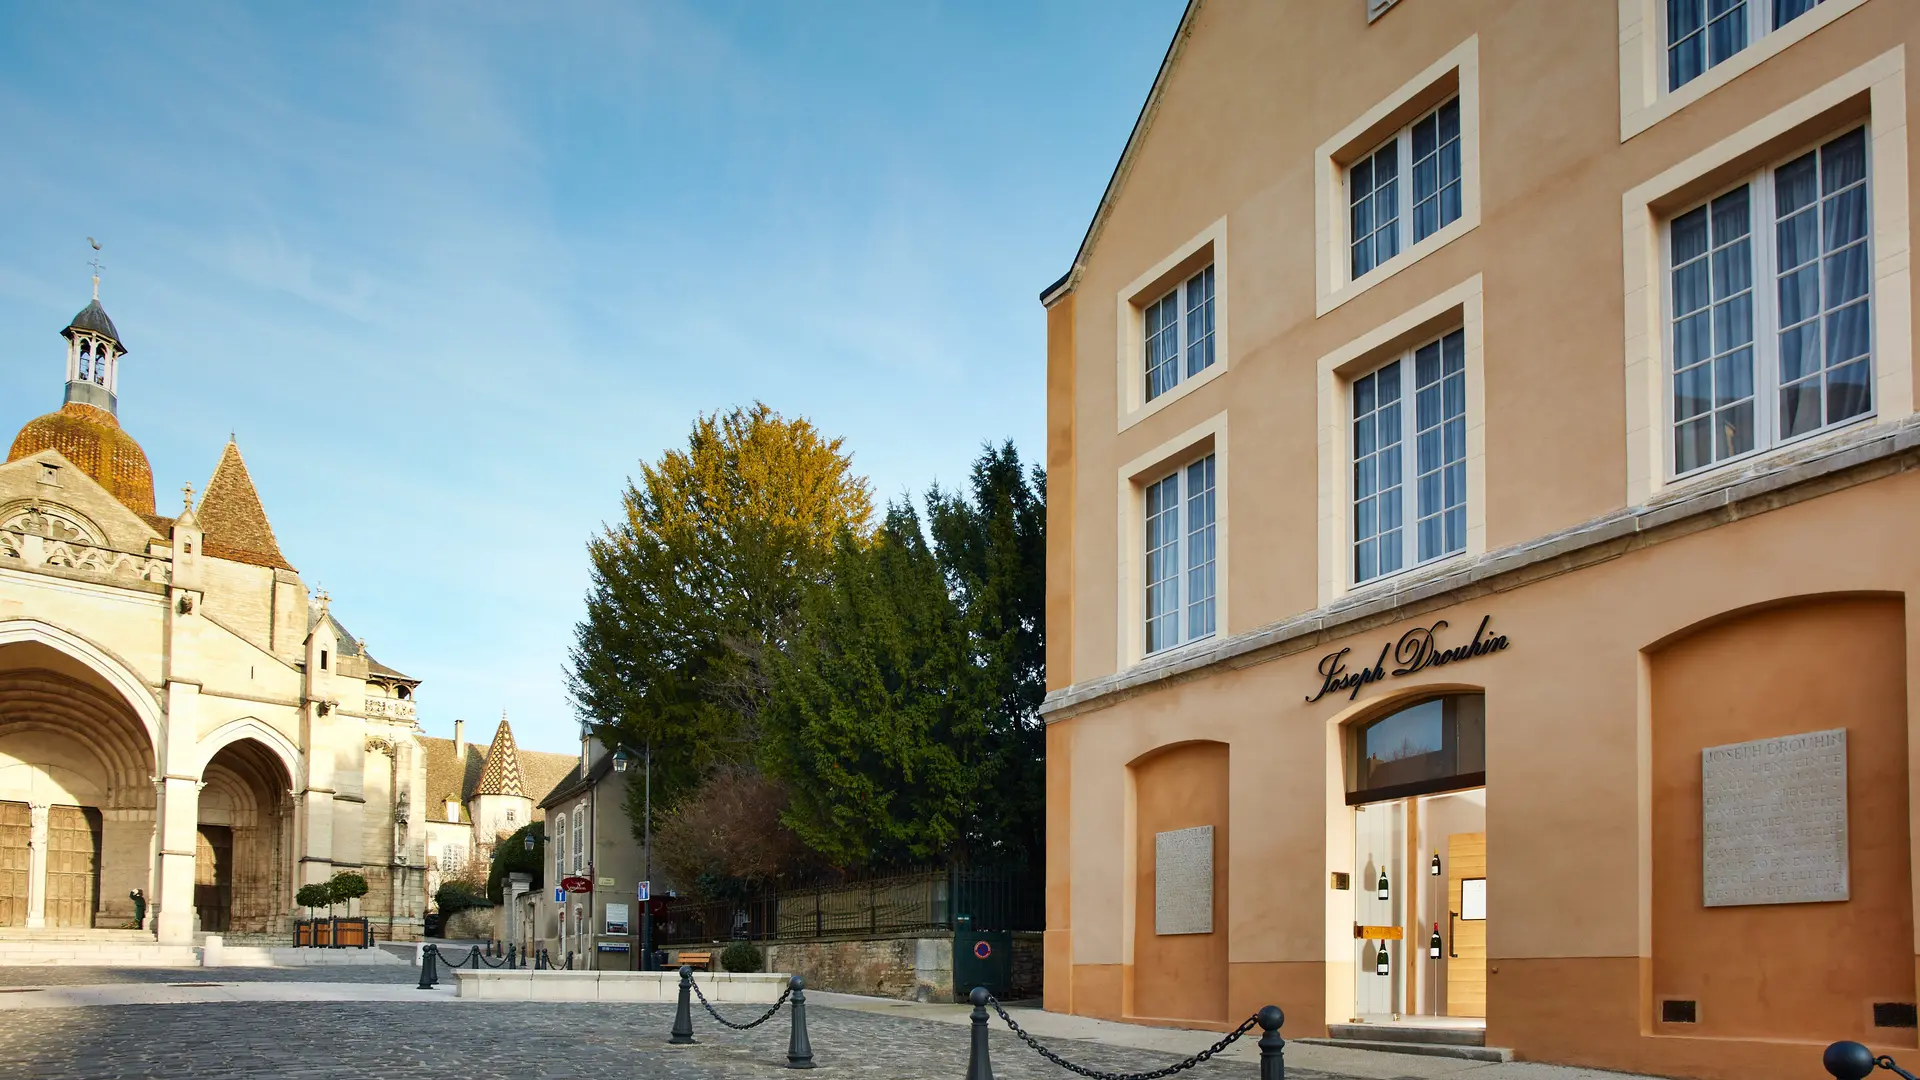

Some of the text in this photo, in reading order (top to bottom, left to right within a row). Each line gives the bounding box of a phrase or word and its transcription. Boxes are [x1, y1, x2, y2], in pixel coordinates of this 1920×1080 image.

[1305, 615, 1510, 702] Joseph Drouhin
[1705, 732, 1842, 764] JOSEPH DROUHIN
[1706, 821, 1722, 832] DE
[1824, 810, 1843, 821] DE
[1750, 803, 1767, 814] ET
